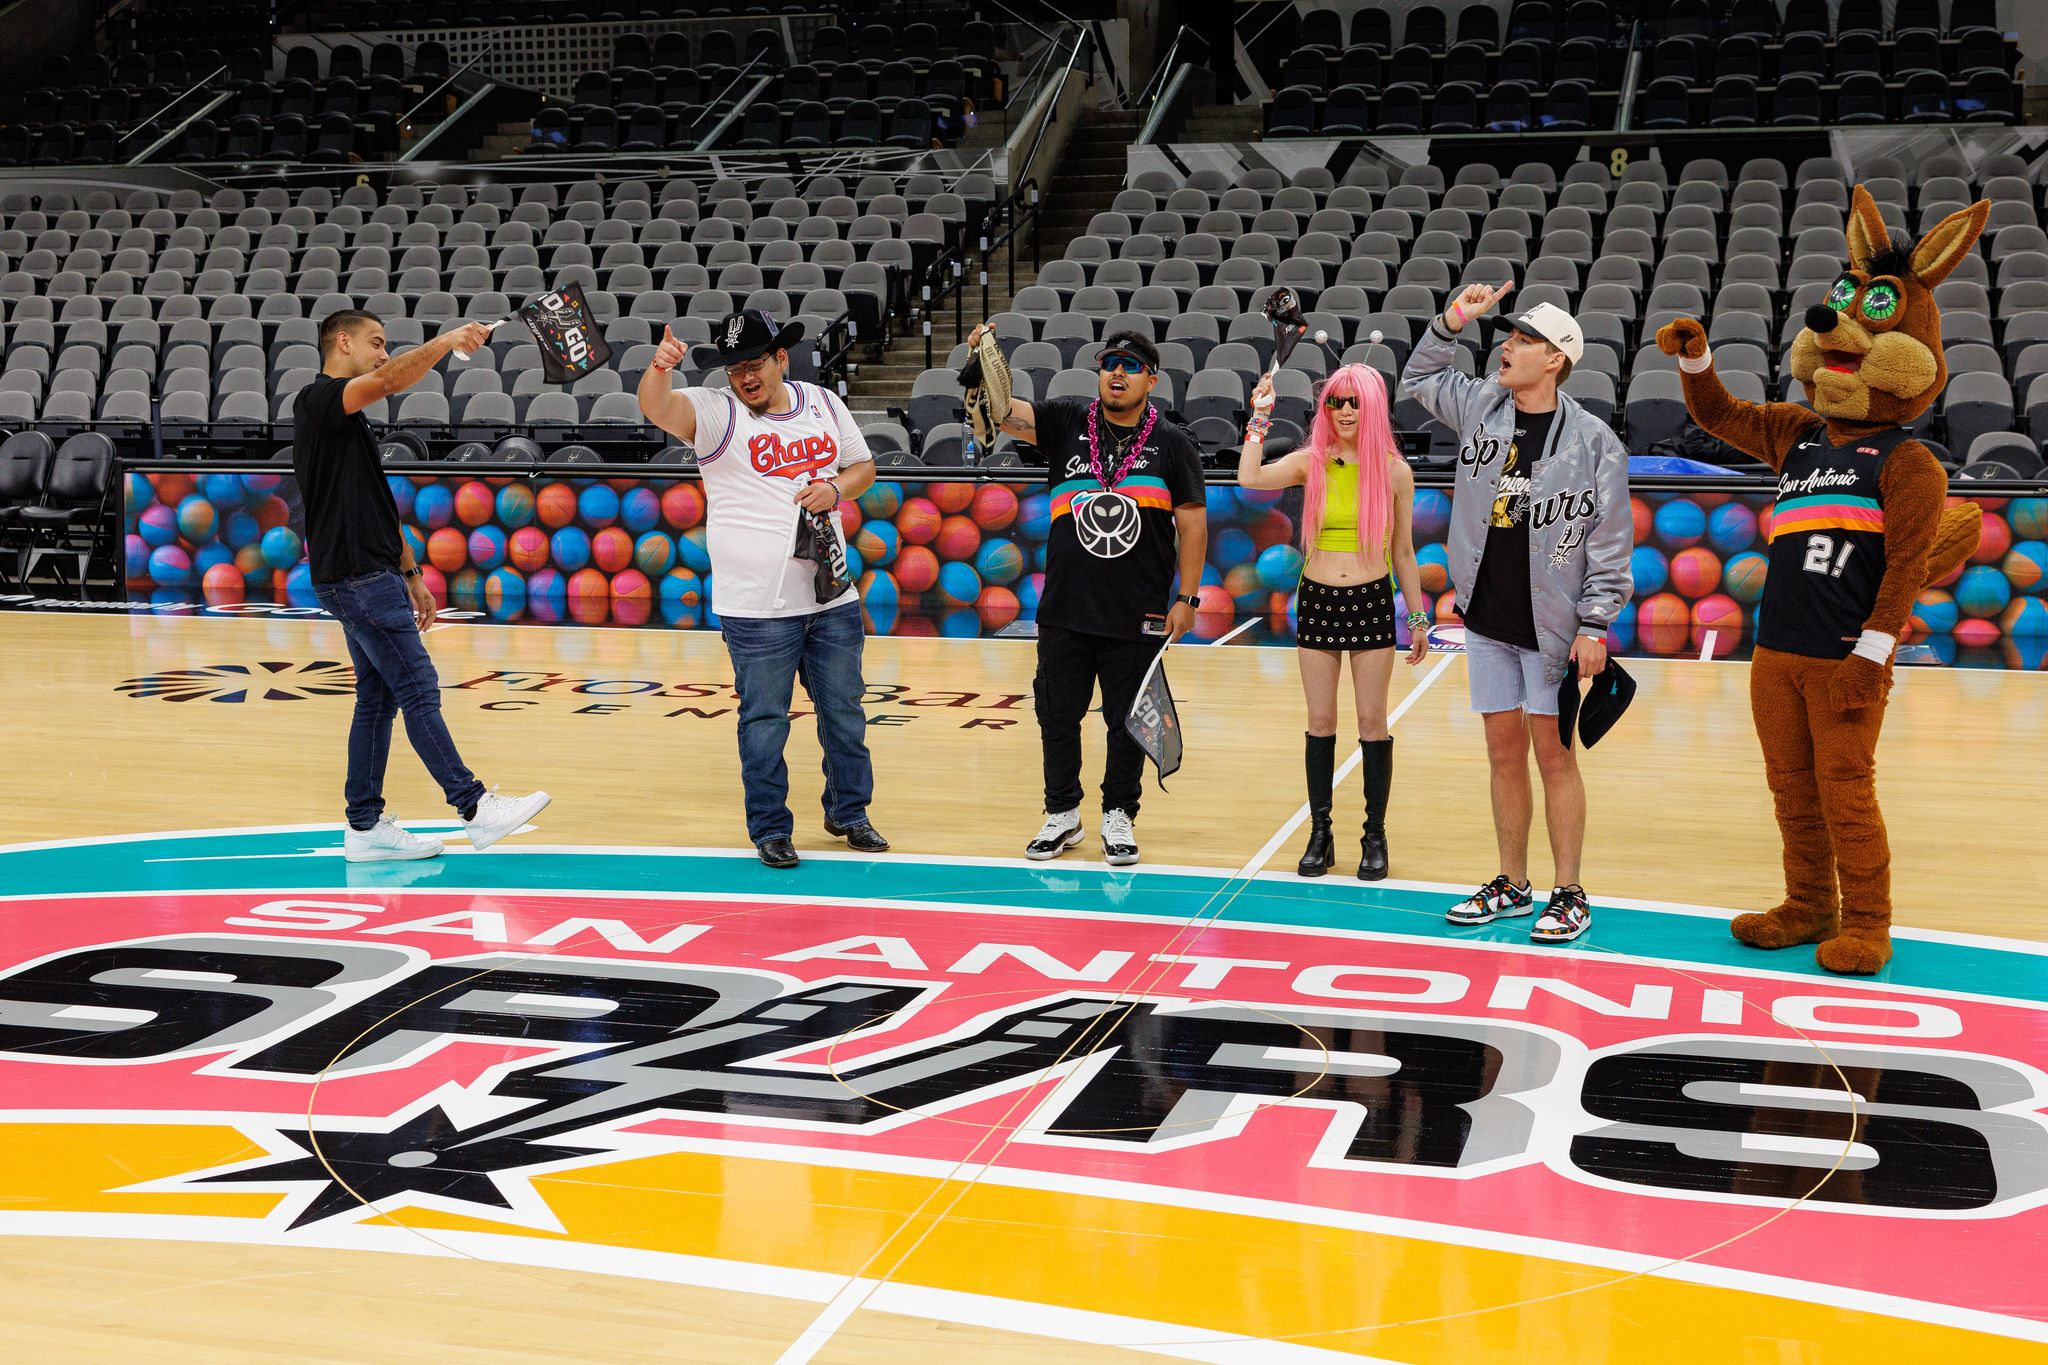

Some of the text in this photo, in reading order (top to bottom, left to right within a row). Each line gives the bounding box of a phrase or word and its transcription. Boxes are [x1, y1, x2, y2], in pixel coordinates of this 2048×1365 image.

[1610, 148, 1628, 177] 8
[538, 291, 587, 363] O GO
[748, 431, 838, 480] Chaps
[1776, 467, 1860, 500] San Antonio
[828, 543, 848, 579] GO
[439, 670, 741, 699] Fros
[223, 899, 1964, 1039] SAN ANTONIO
[0, 938, 2048, 1230] SPURS
